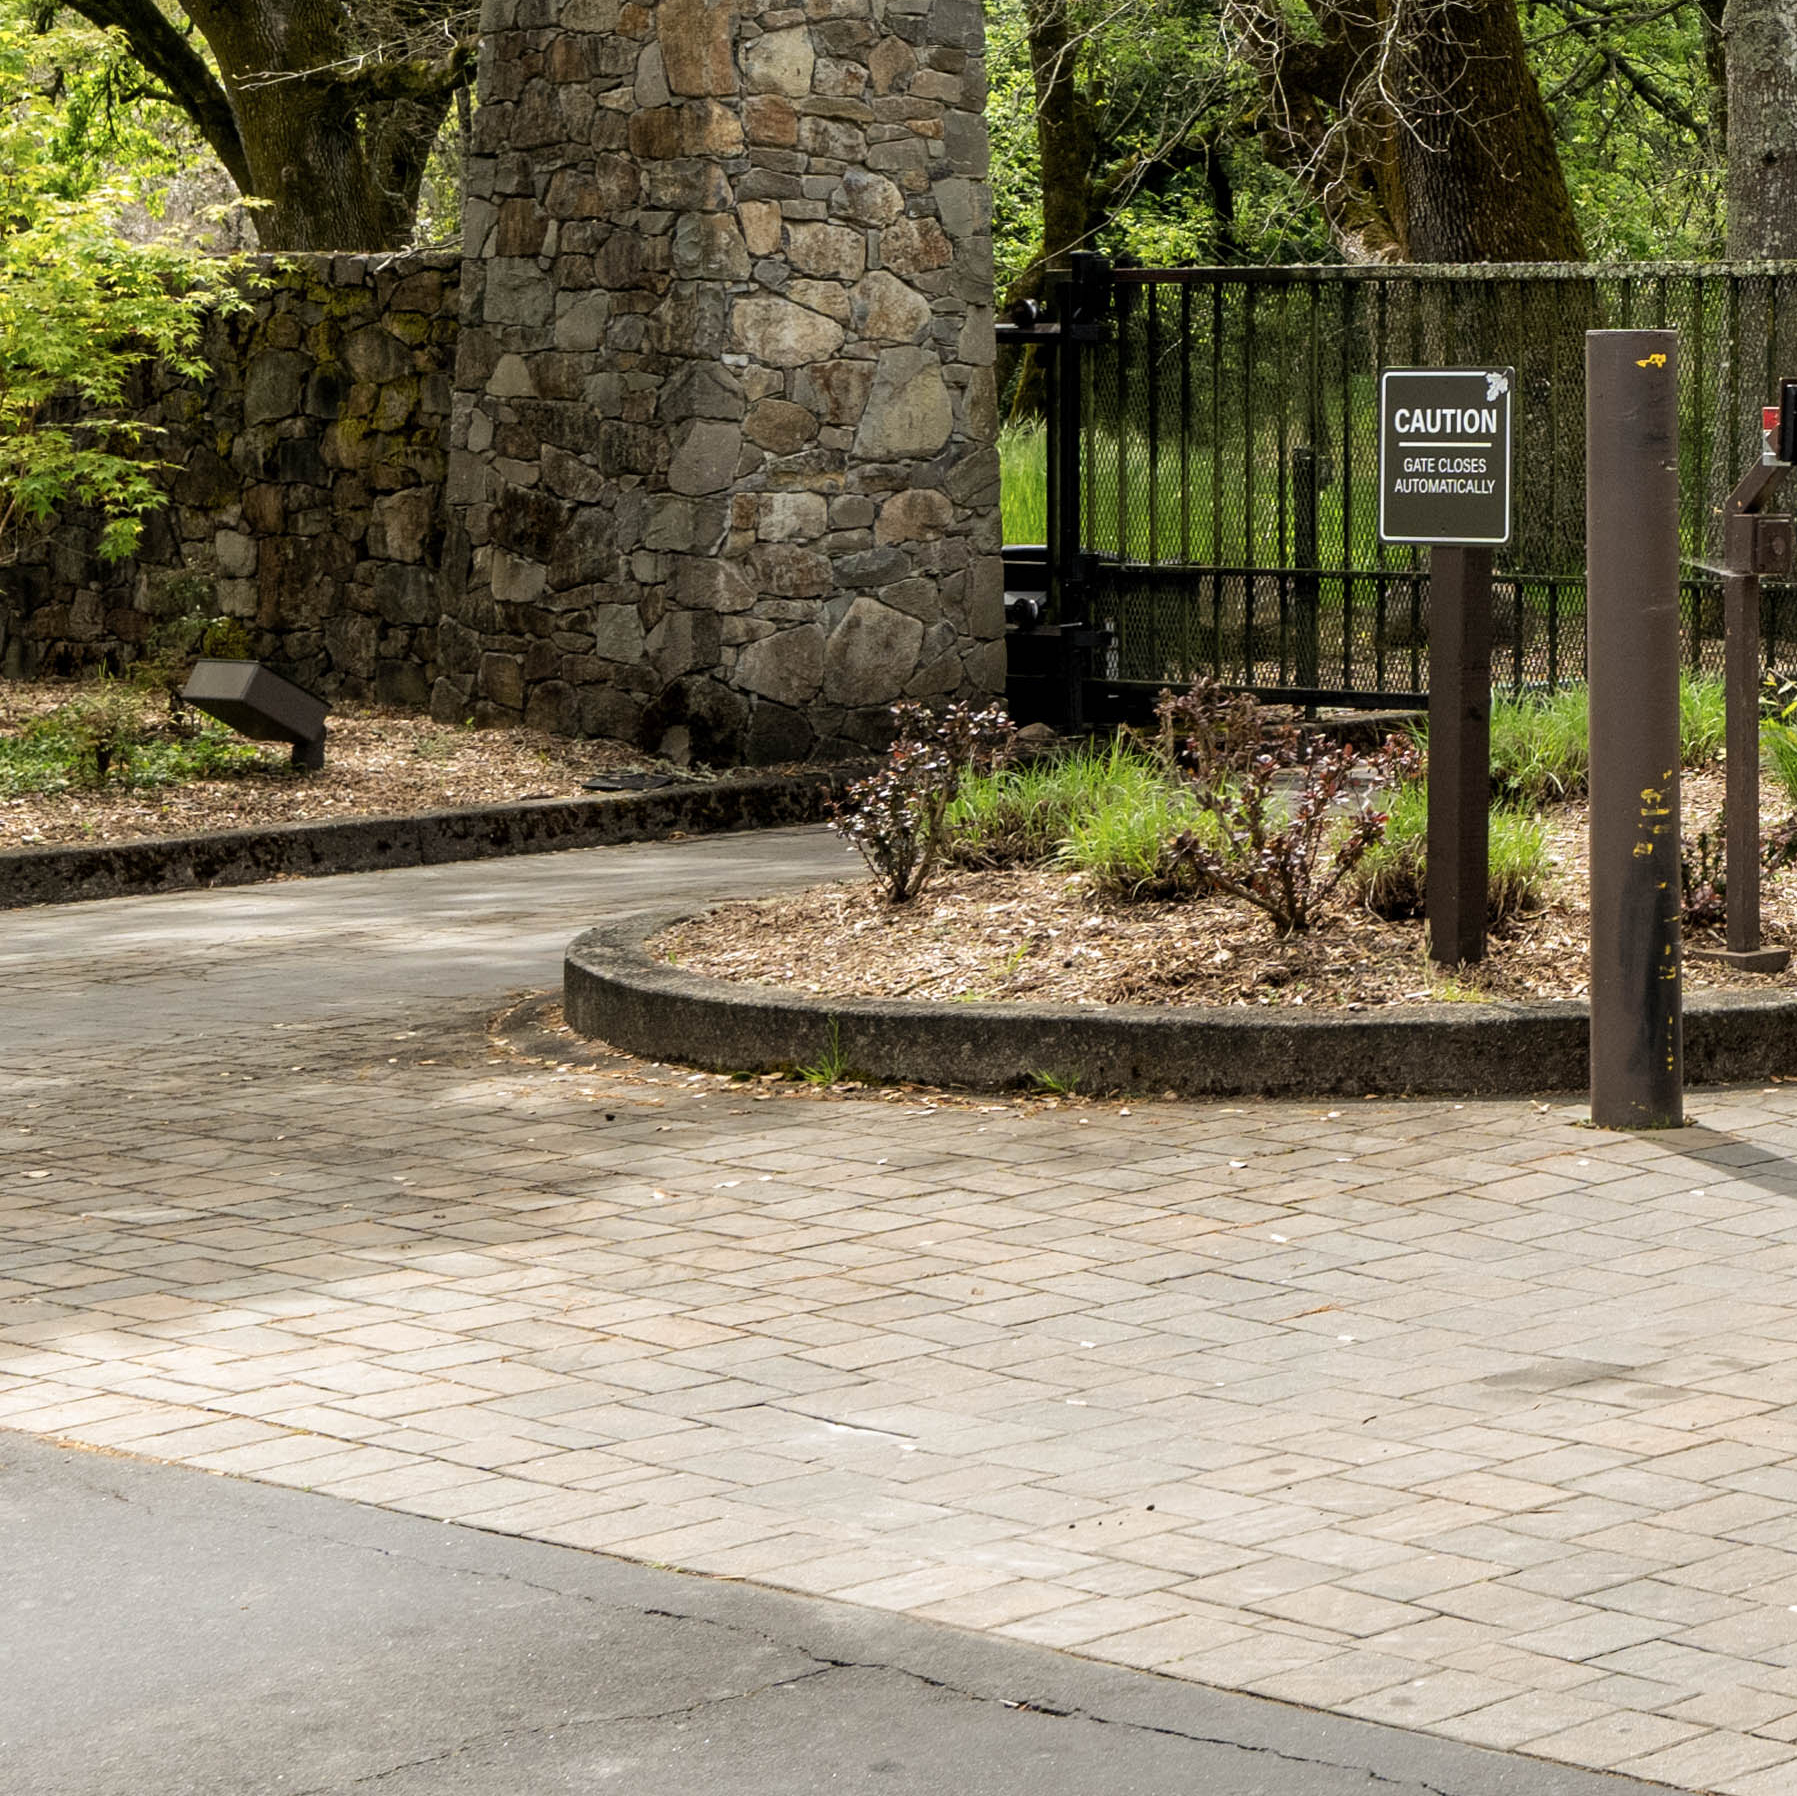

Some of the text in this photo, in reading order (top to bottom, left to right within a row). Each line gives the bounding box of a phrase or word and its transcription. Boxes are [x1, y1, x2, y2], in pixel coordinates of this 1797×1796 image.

[1394, 408, 1497, 434] CAUTION
[1403, 457, 1488, 474] GATE CLOSES
[1394, 478, 1496, 495] AUTOMATICALLY
